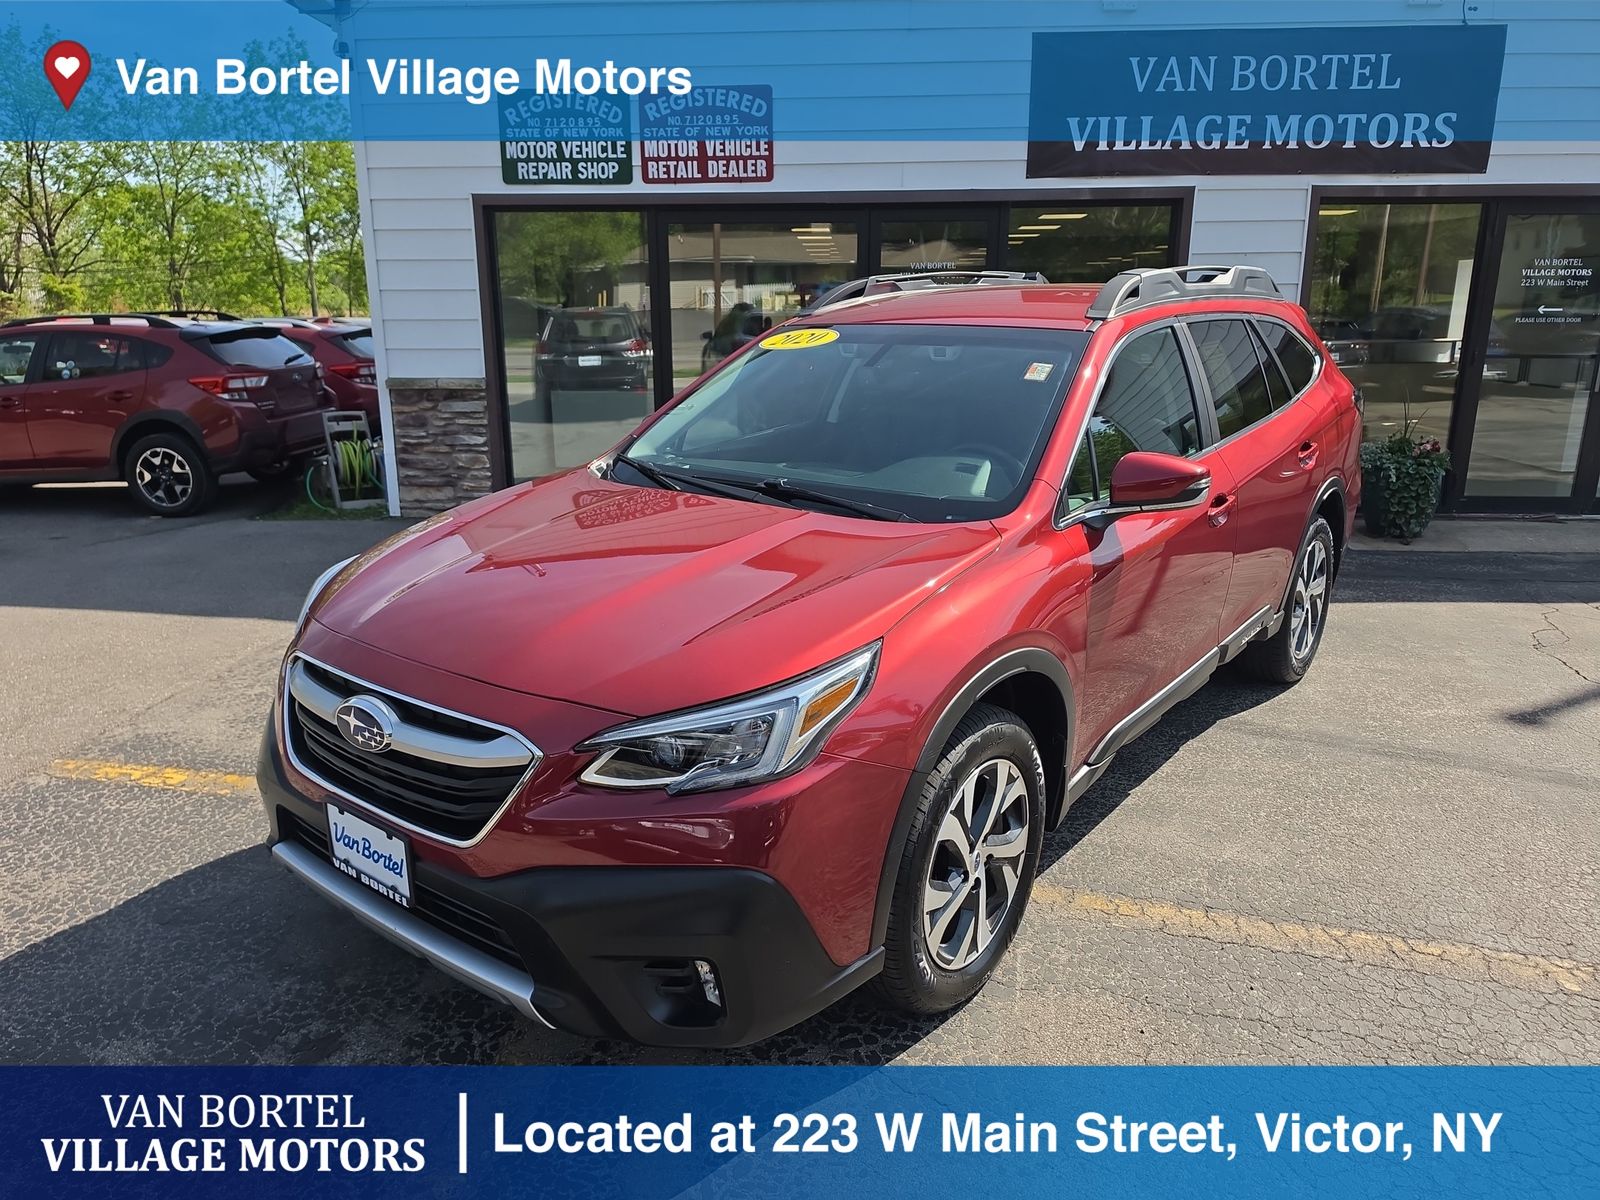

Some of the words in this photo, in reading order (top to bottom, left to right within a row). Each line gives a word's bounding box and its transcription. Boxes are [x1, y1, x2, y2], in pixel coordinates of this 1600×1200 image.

[1129, 56, 1218, 93] VAN
[1230, 53, 1401, 92] BORTEL
[504, 91, 623, 126] REGISTERED
[644, 88, 768, 121] REGISTERED
[684, 114, 740, 125] 7120895
[506, 128, 540, 138] STATE
[544, 128, 560, 138] OF
[563, 128, 589, 137] NEW
[593, 127, 624, 137] YORK
[643, 127, 680, 137] STATE
[685, 127, 701, 137] OF
[705, 126, 731, 136] NEW
[736, 125, 769, 136] YORK
[1067, 114, 1252, 152] VILLAGE
[1262, 112, 1458, 150] MOTORS
[505, 141, 558, 159] MOTOR
[561, 140, 627, 159] VEHICLE
[644, 140, 699, 158] MOTOR
[705, 138, 769, 157] VEHICLE
[517, 162, 572, 180] REPAIR
[578, 161, 619, 179] SHOP
[647, 161, 702, 179] RETAIL
[707, 159, 767, 178] DEALER
[927, 261, 956, 269] BORTEL
[1534, 258, 1551, 266] VAN
[1552, 258, 1583, 266] BORTEL
[1522, 268, 1556, 276] VILLAGE
[1557, 268, 1593, 276] MOTORS
[333, 857, 357, 878] VAN
[361, 873, 409, 908] BORTEL
